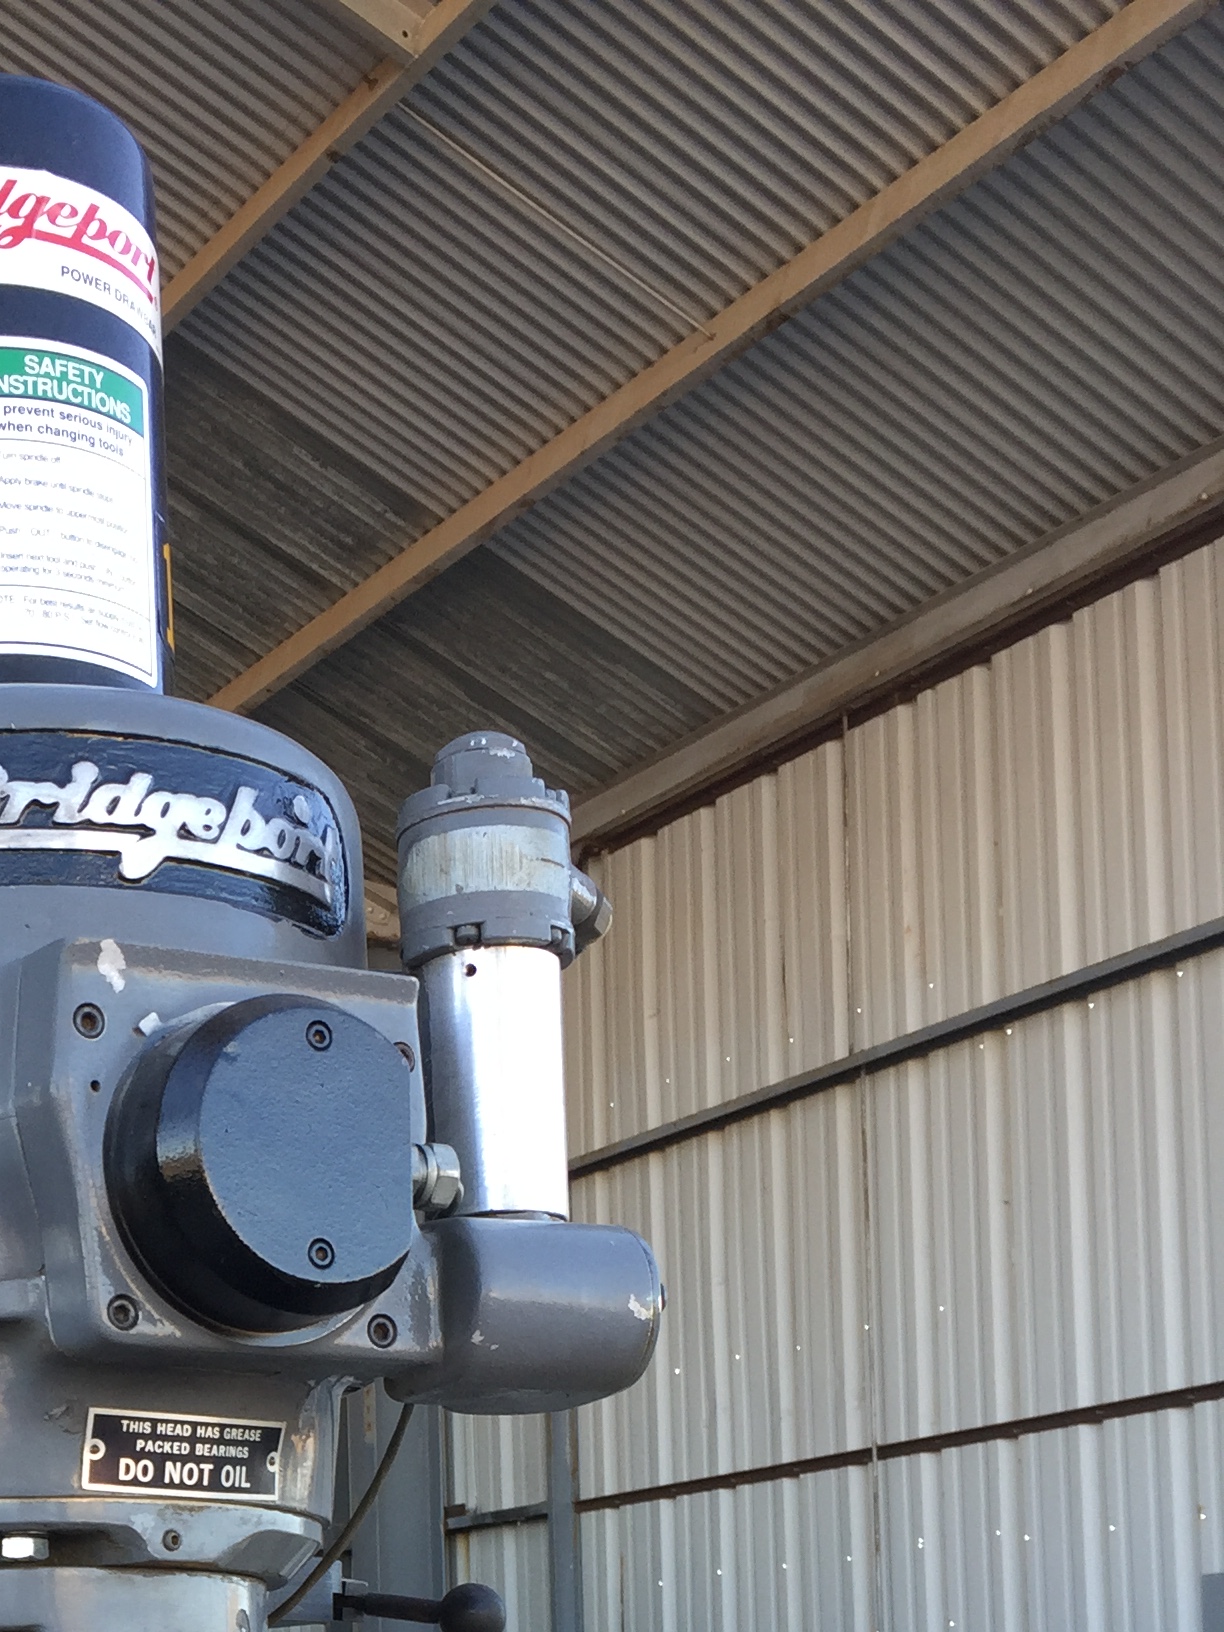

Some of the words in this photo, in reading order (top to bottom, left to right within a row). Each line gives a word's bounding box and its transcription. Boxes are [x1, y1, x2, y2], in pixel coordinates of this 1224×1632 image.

[61, 266, 111, 295] POWER
[23, 354, 104, 389] SAFETY
[3, 405, 54, 421] prevent
[59, 409, 103, 429] serious
[106, 422, 133, 446] injury
[37, 424, 95, 446] changing
[98, 440, 124, 457] tools
[121, 1419, 151, 1434] THIS
[157, 1422, 192, 1437] HEAD
[196, 1425, 220, 1439] HAS
[223, 1428, 262, 1442] GREASE
[136, 1439, 189, 1455] PACKED
[195, 1443, 249, 1459] BEARINGS
[119, 1457, 154, 1482] DO
[164, 1461, 214, 1486] NOT
[221, 1465, 251, 1488] OIL
